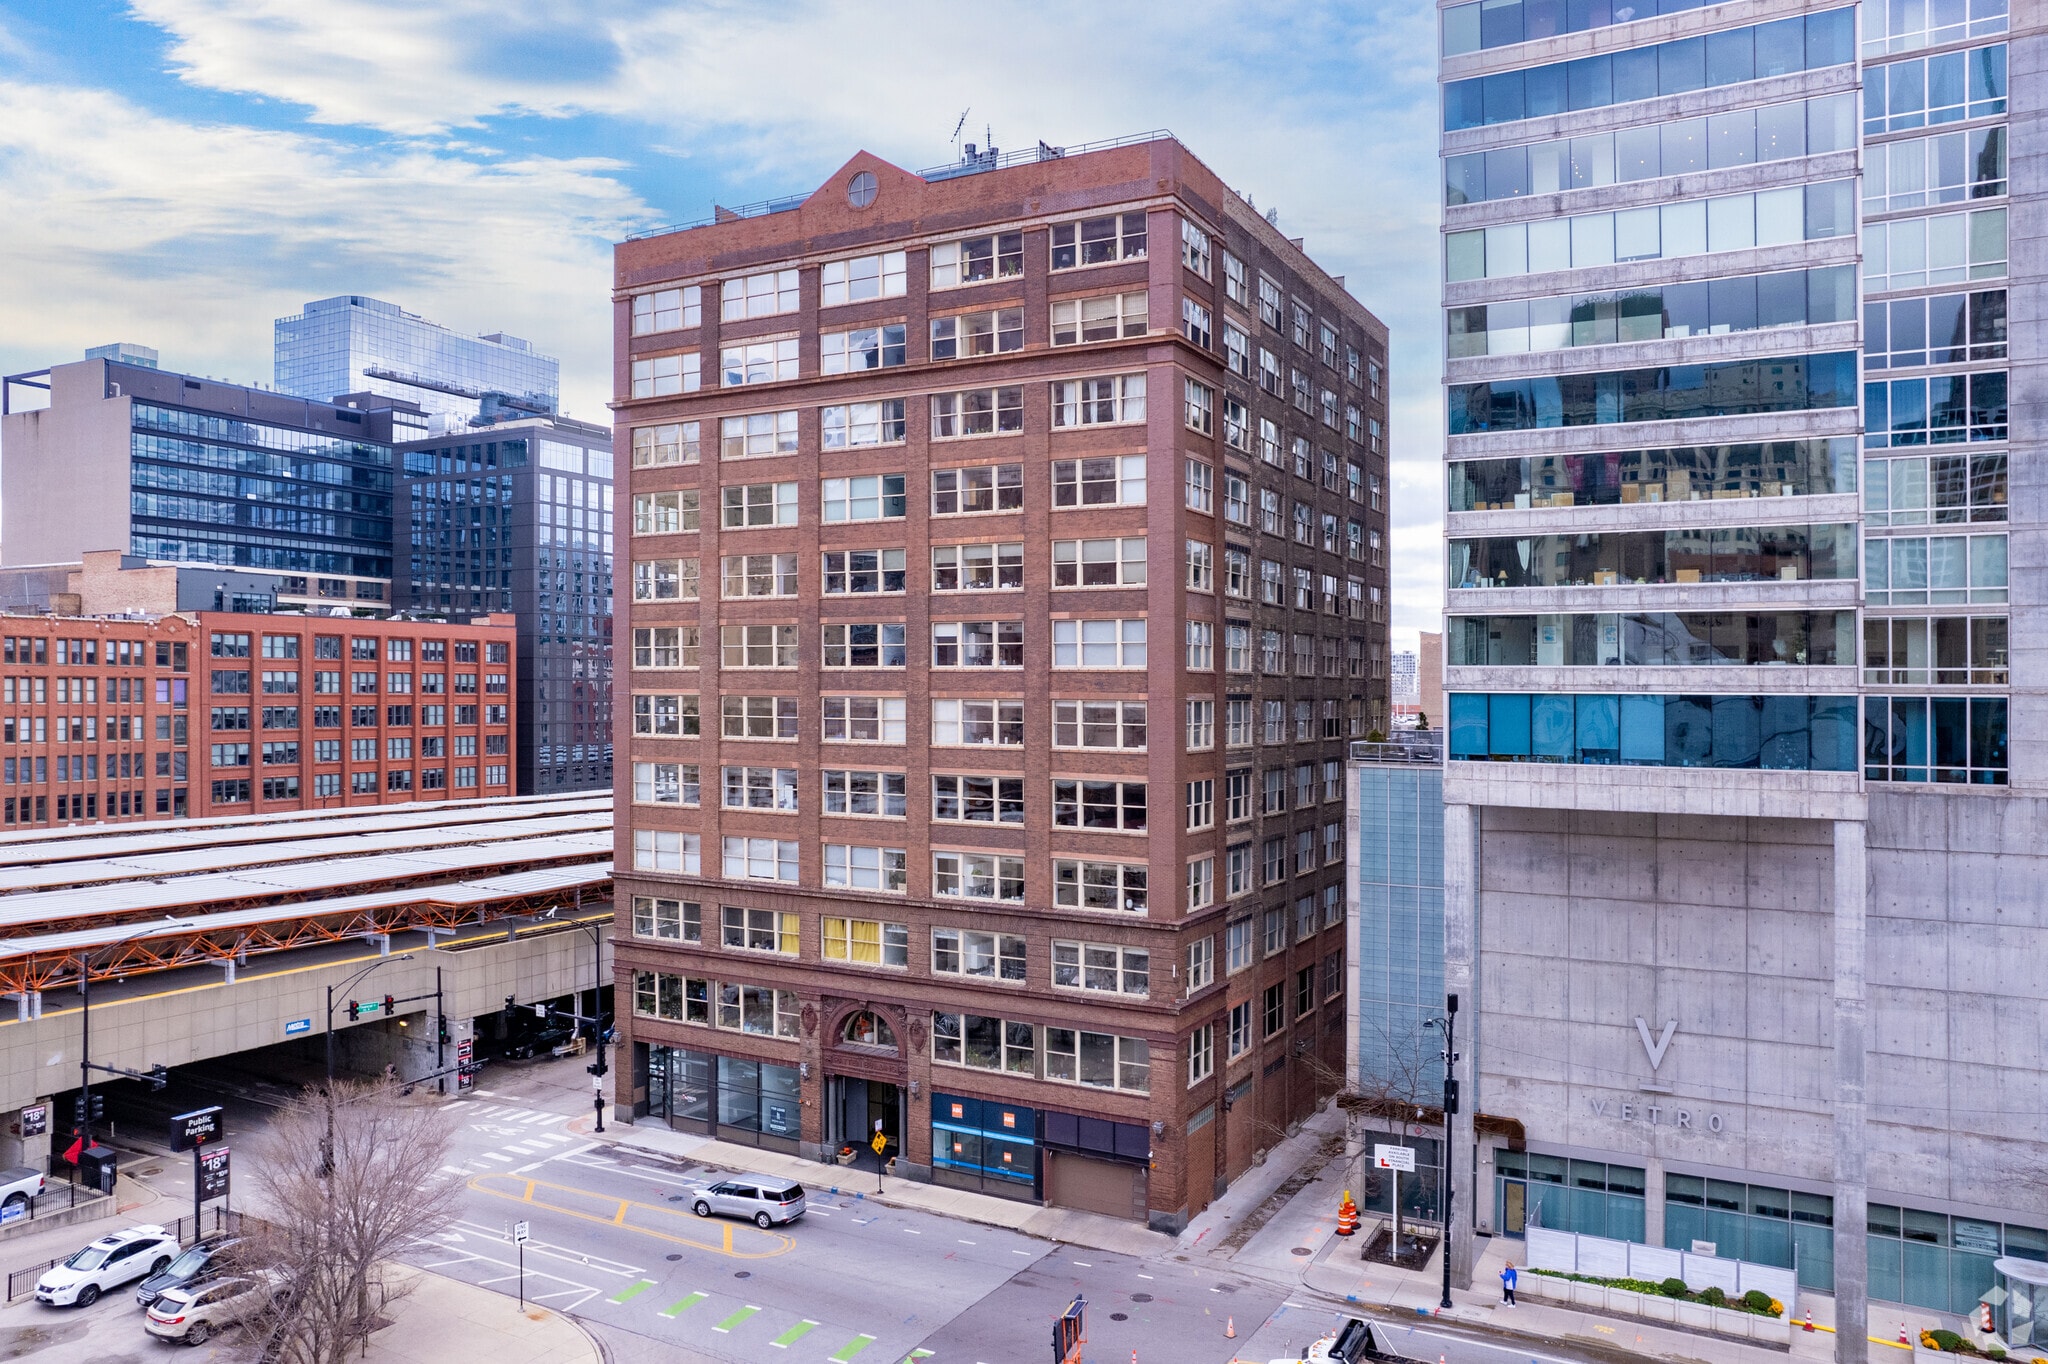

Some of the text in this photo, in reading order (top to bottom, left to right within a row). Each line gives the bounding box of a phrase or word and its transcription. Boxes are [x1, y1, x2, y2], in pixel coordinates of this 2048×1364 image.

[1634, 1017, 1678, 1071] V
[188, 1115, 212, 1127] Public
[1592, 1099, 1723, 1133] VETRO
[185, 1123, 215, 1136] Parking
